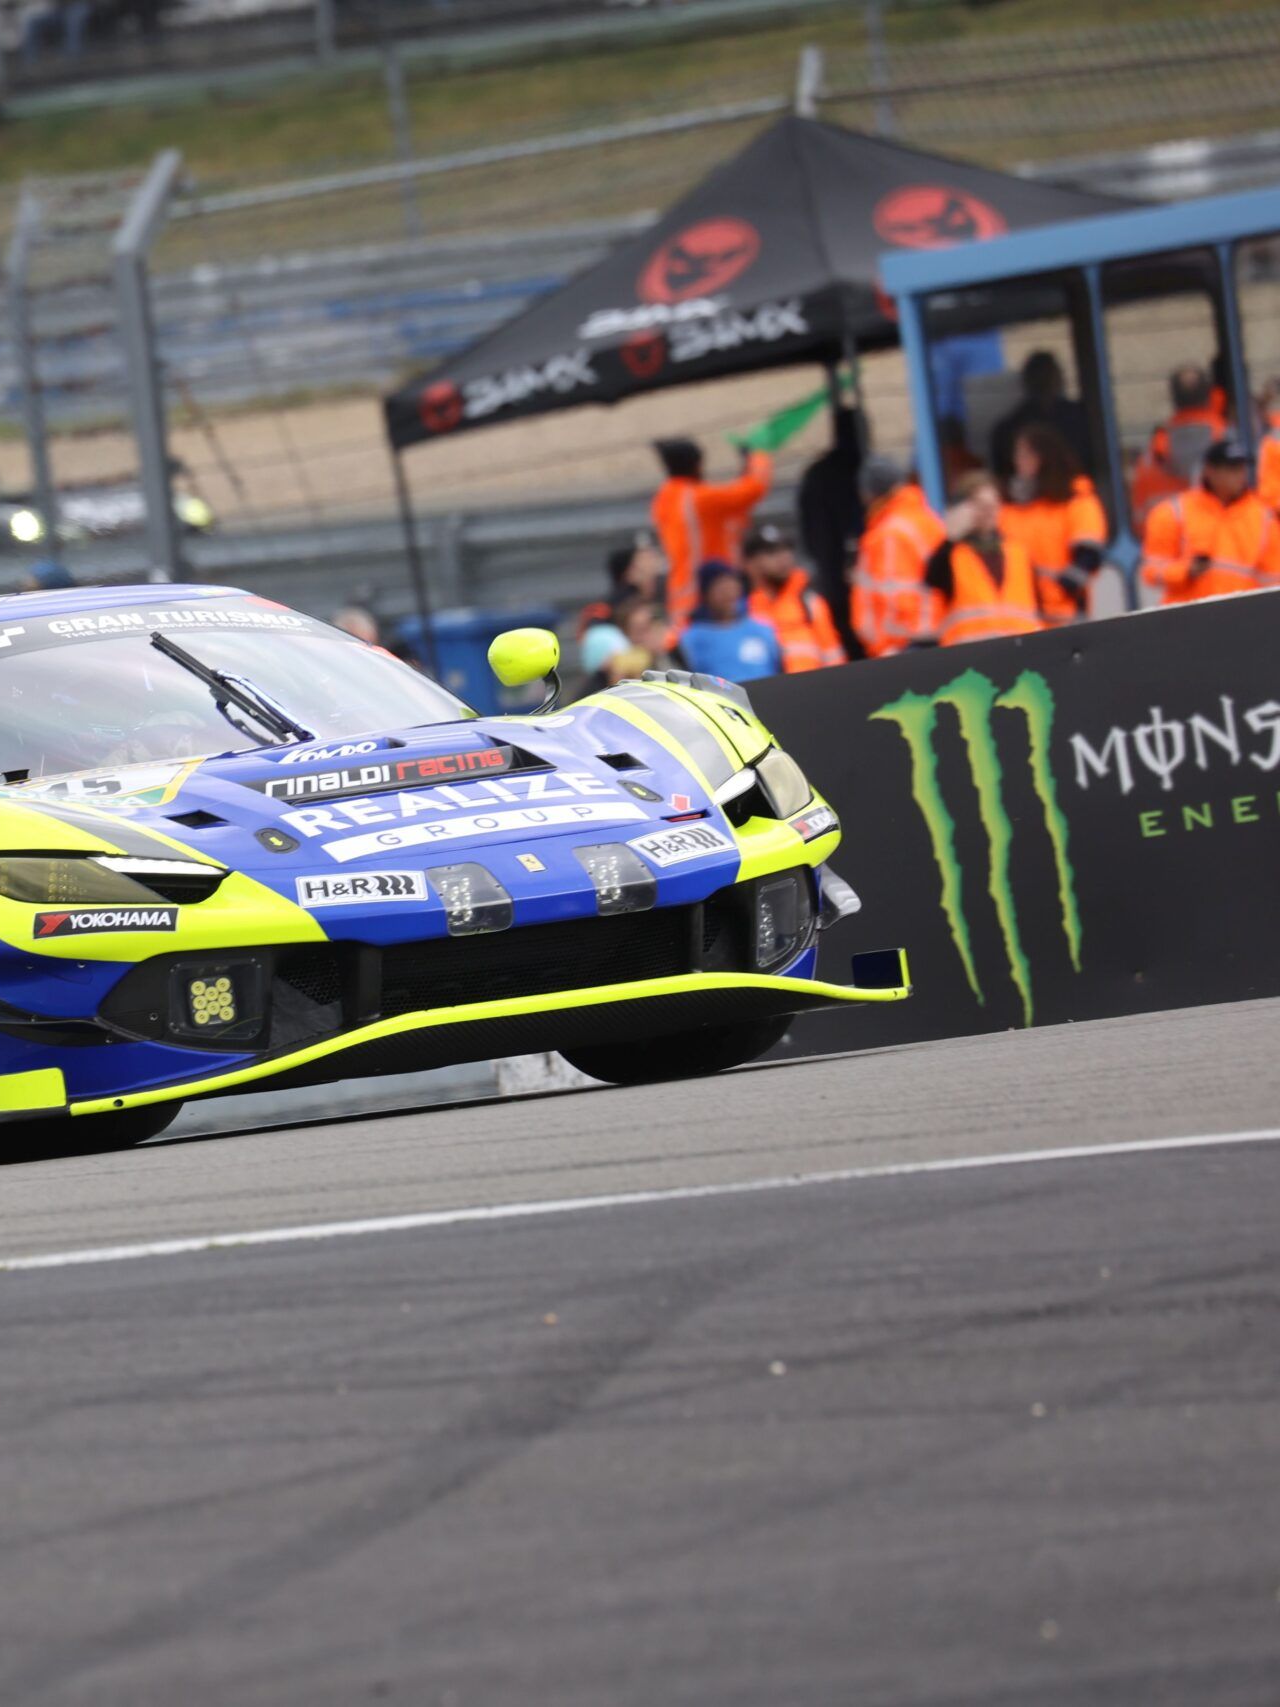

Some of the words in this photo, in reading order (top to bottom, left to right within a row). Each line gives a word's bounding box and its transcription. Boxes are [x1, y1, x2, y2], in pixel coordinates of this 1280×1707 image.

[48, 612, 145, 635] GRAN
[149, 609, 305, 628] TURISMO
[63, 629, 97, 639] THE
[99, 625, 145, 635] REAL
[279, 772, 619, 838] REALIZE
[1139, 790, 1280, 838] ENE
[376, 807, 594, 846] GROUP
[639, 835, 697, 858] H&R
[305, 878, 372, 899] H&R
[70, 911, 172, 930] YOKOHAMA
